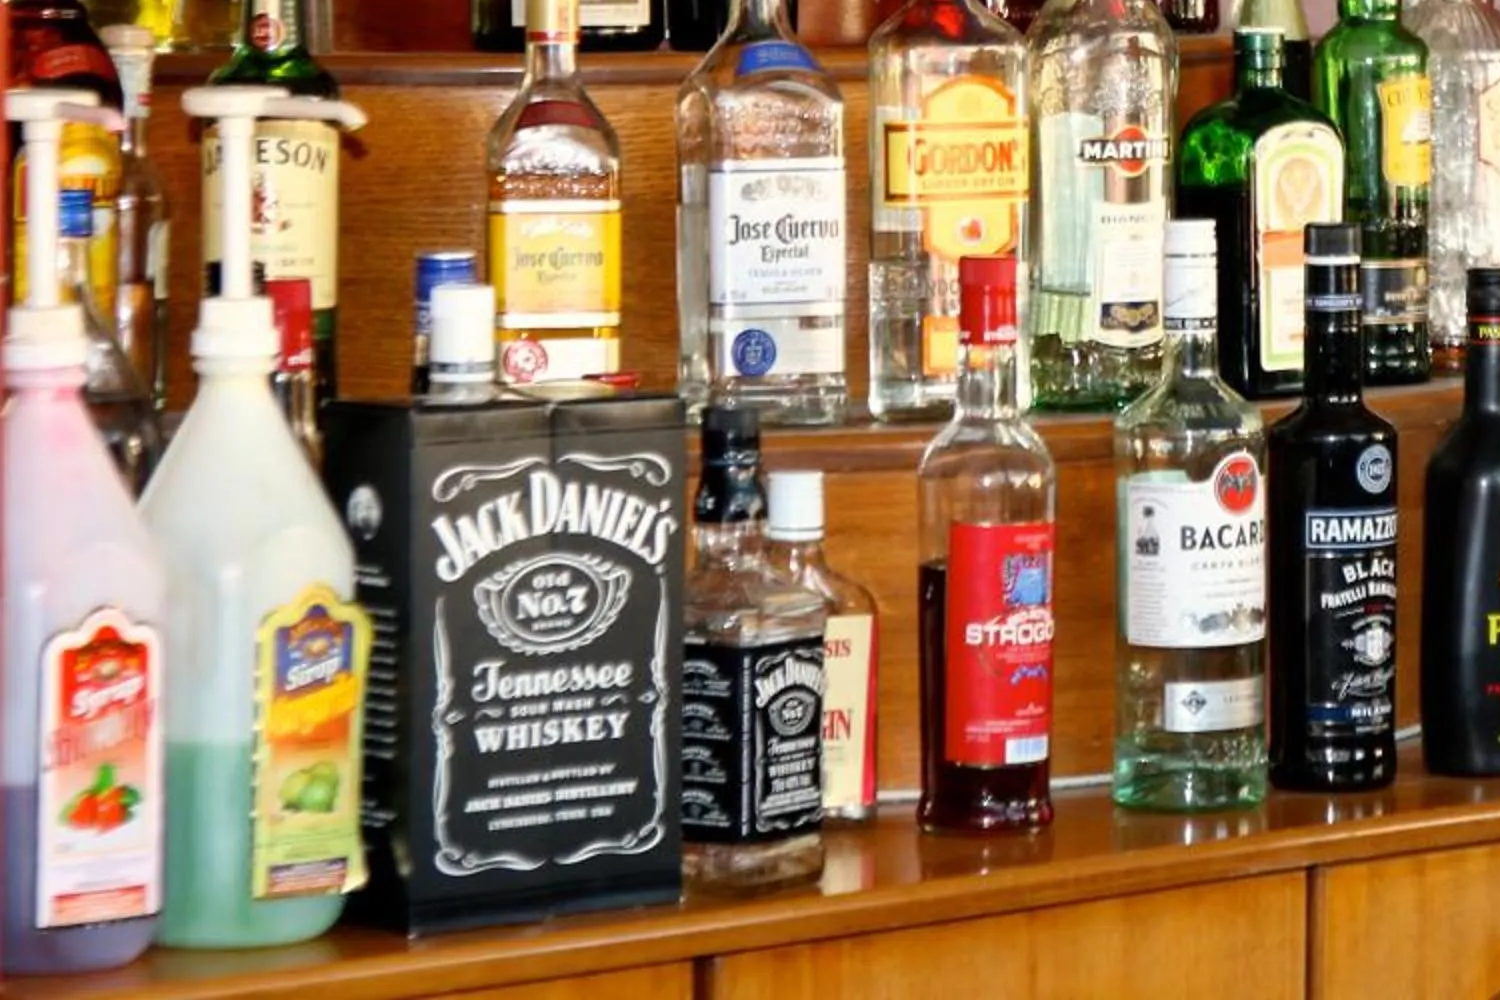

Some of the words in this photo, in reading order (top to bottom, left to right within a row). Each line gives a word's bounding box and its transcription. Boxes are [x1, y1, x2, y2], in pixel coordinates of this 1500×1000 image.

[204, 139, 328, 175] JESON
[430, 490, 530, 583] JACK
[528, 470, 679, 565] DANIEL'S
[472, 661, 633, 703] Tennessee
[474, 711, 631, 754] WHISKEY
